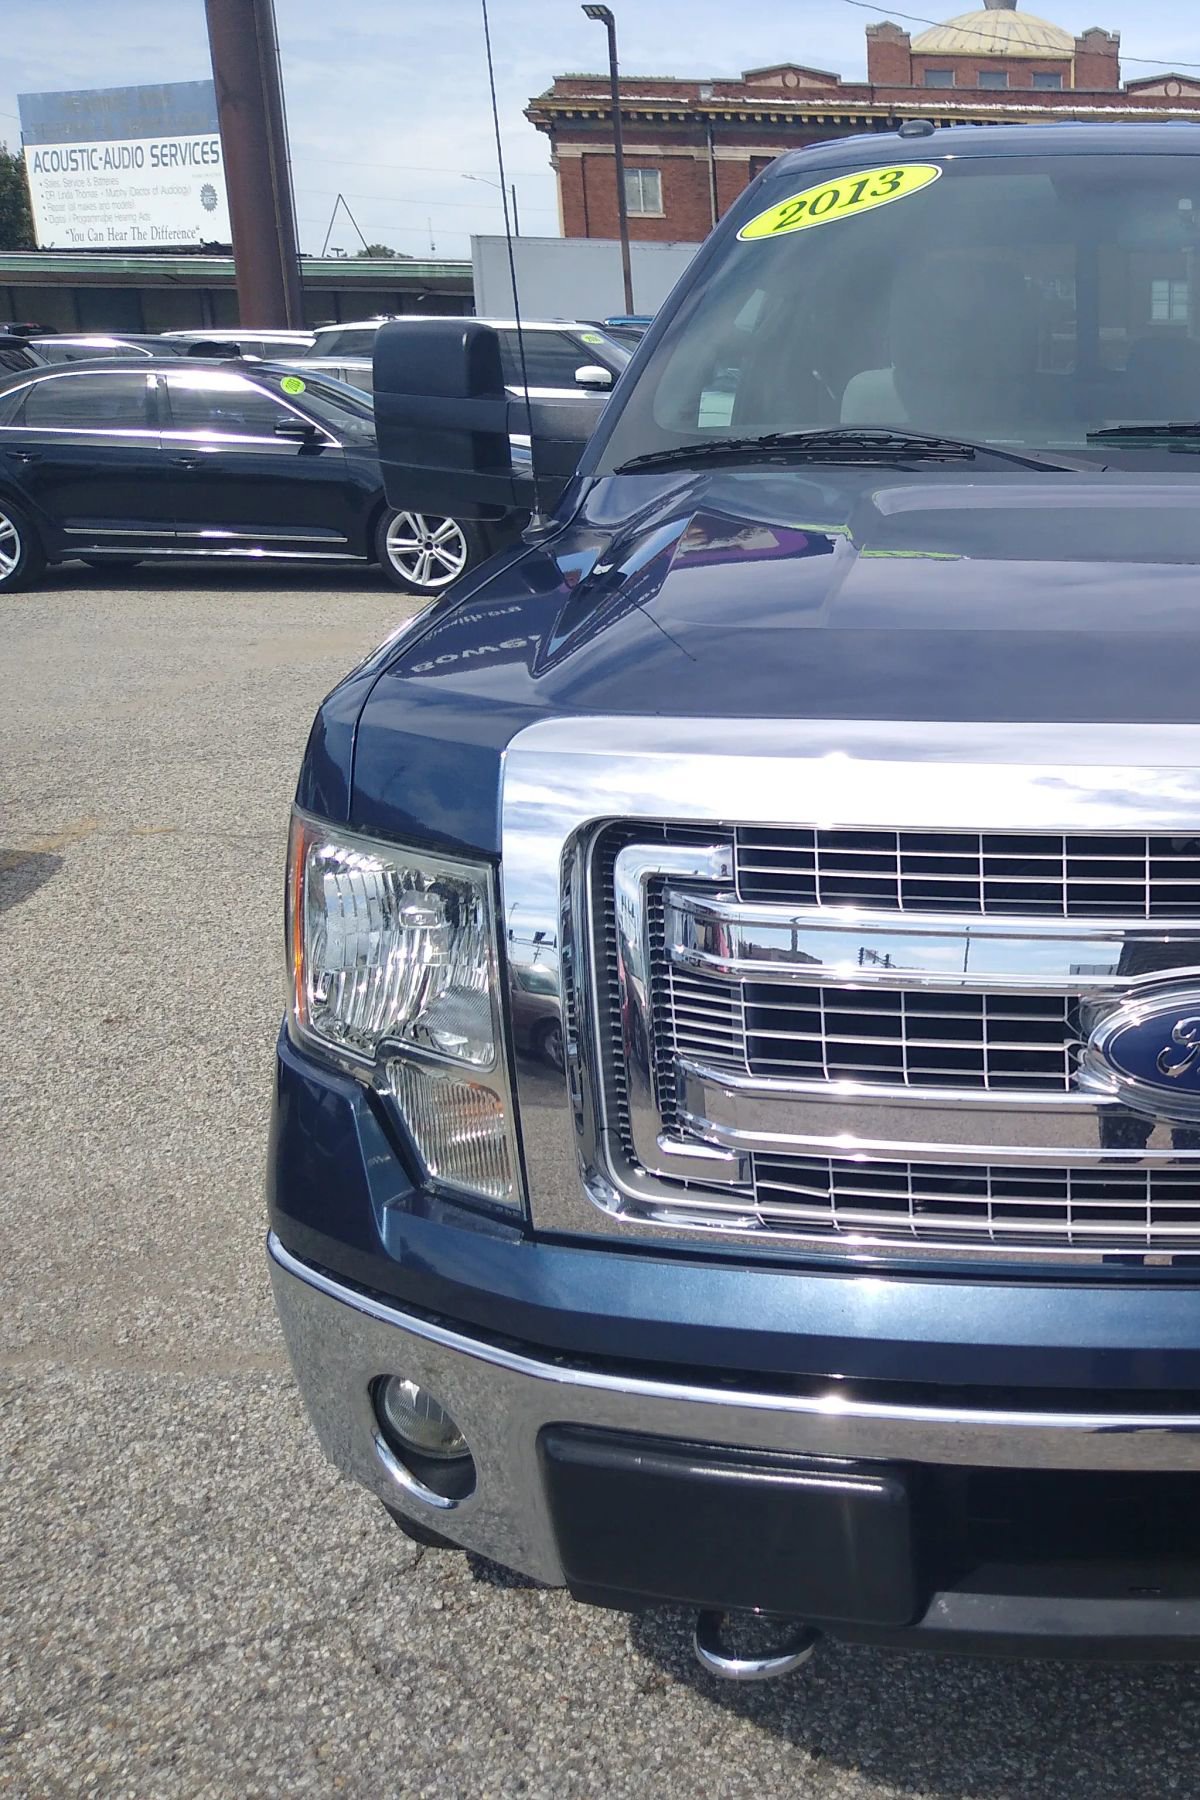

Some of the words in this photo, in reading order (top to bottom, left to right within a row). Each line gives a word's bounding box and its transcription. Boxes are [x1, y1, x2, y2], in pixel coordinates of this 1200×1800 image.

[150, 140, 220, 168] SERVICES
[773, 170, 904, 231] 2013
[87, 227, 104, 242] Can
[107, 226, 128, 241] Hear
[130, 226, 148, 241] The
